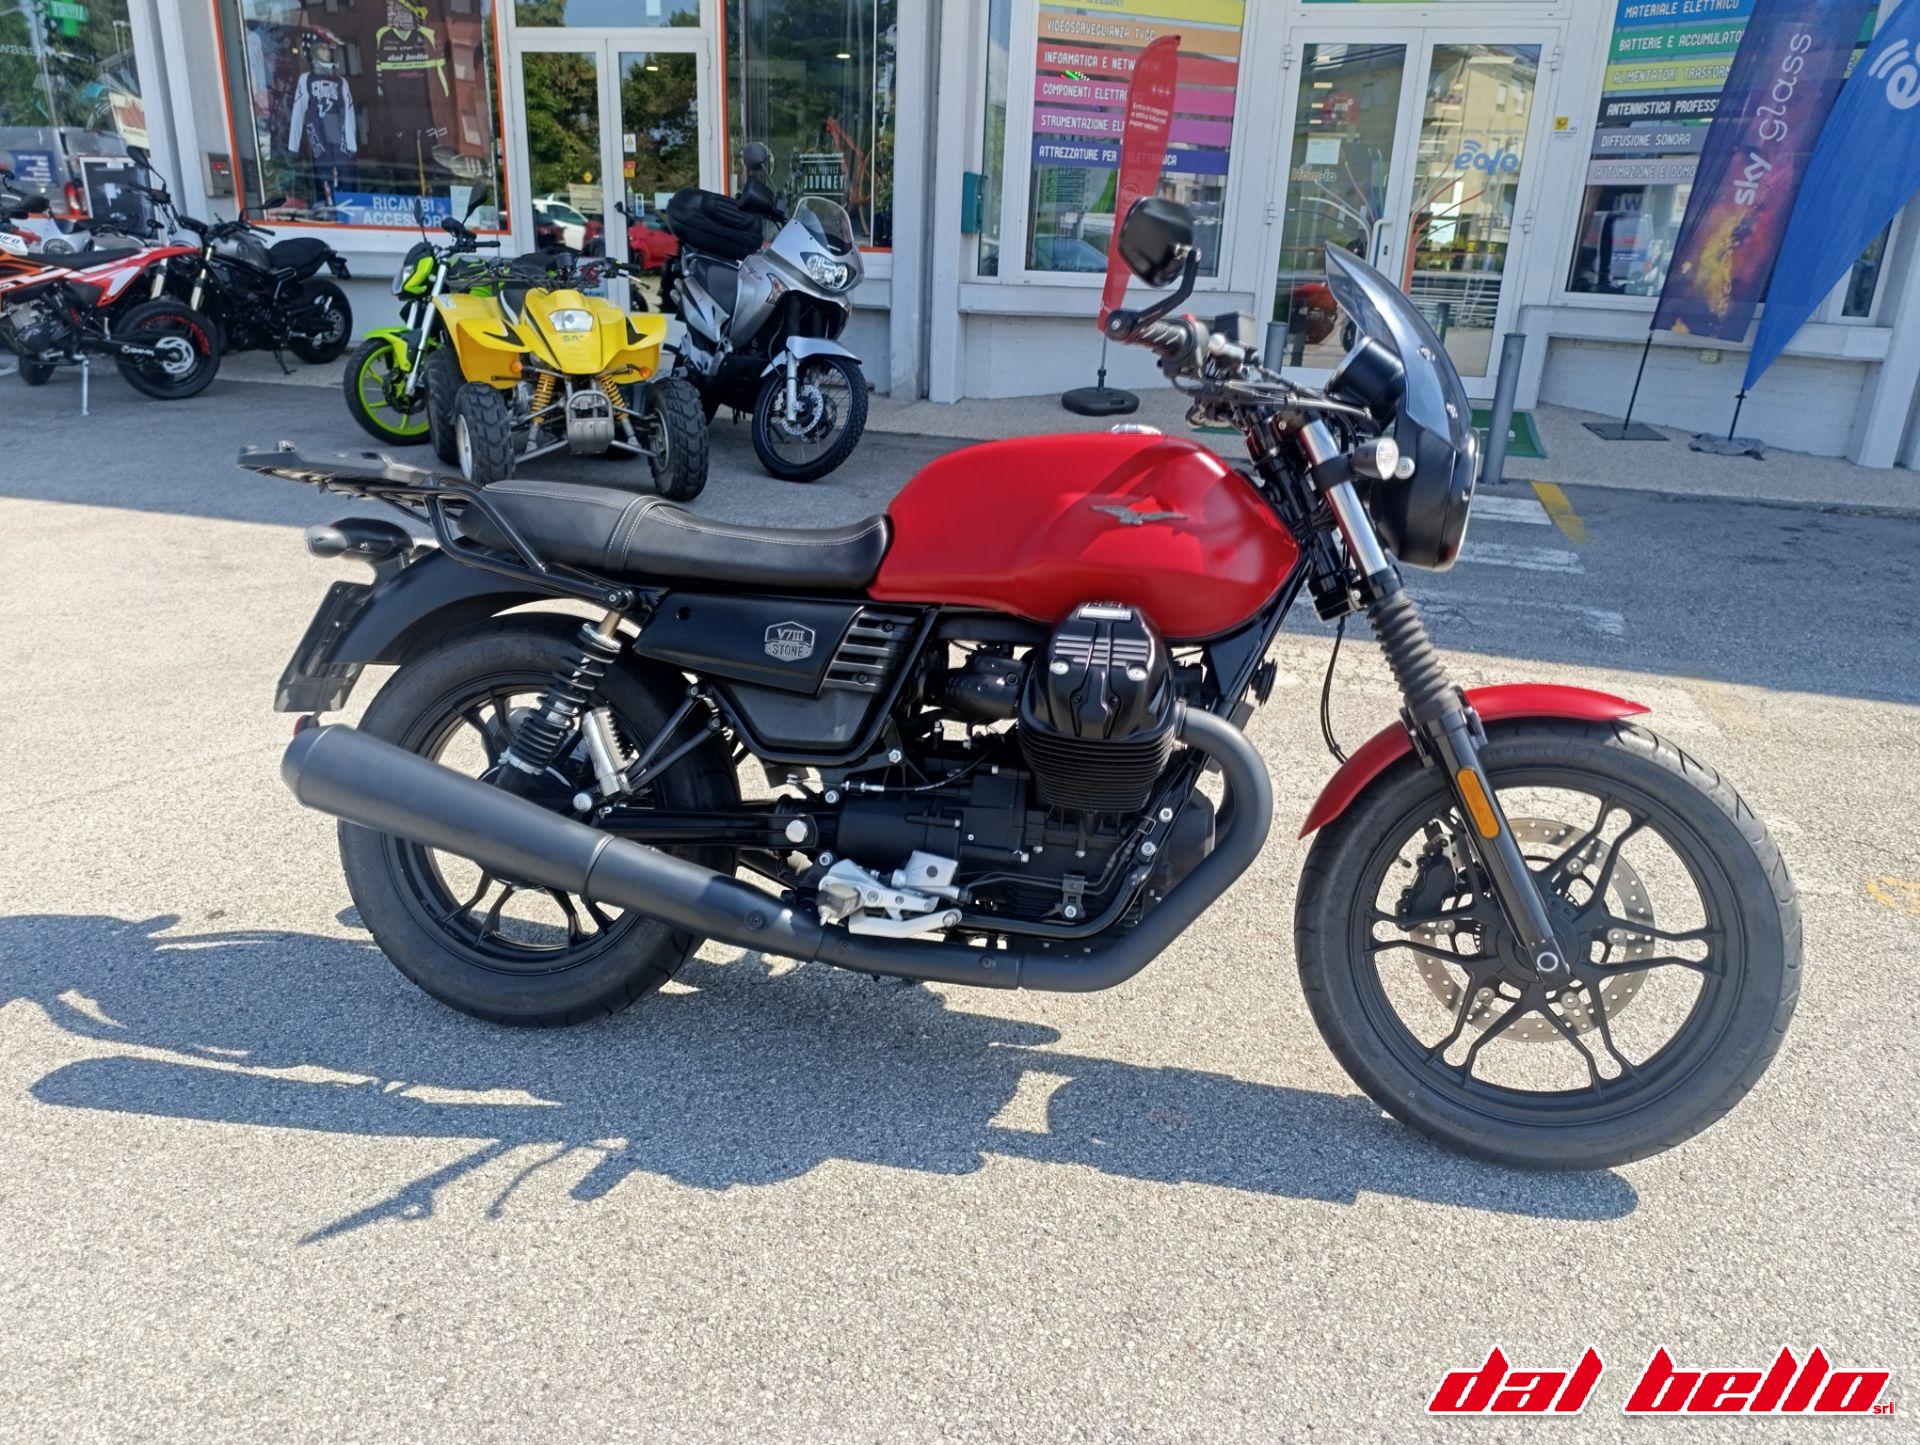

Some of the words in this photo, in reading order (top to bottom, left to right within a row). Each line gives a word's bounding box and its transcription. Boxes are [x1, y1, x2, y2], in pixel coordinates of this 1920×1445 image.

[1624, 1, 1678, 18] MATERIALE
[1683, 0, 1739, 14] ELETTRICO
[1046, 19, 1130, 39] VIDEOSORVEGLIANZA
[1619, 36, 1662, 51] BATTERIE
[1667, 35, 1675, 48] E
[1678, 30, 1745, 47] ACCUMULATO
[1044, 52, 1098, 68] INFORMATICA
[1102, 57, 1107, 68] E
[1612, 67, 1678, 85] ALIMENTATORI
[1043, 83, 1091, 99] COMPONENTI
[1606, 100, 1670, 116] ANTENNISTICA
[1674, 99, 1720, 113] PROFESS
[1040, 115, 1108, 131] STRUMENTAZIONE
[1733, 152, 1772, 206] sky
[1757, 33, 1812, 142] glass
[1601, 134, 1651, 147] DIFFUSIONE
[1655, 133, 1691, 145] SONORA
[1039, 146, 1098, 161] ATTREZZATURE
[1102, 150, 1117, 162] PER
[1454, 147, 1518, 176] eolo
[1595, 165, 1655, 178] AUTOMAZIONE
[1660, 166, 1666, 177] E
[773, 643, 803, 657] STONE
